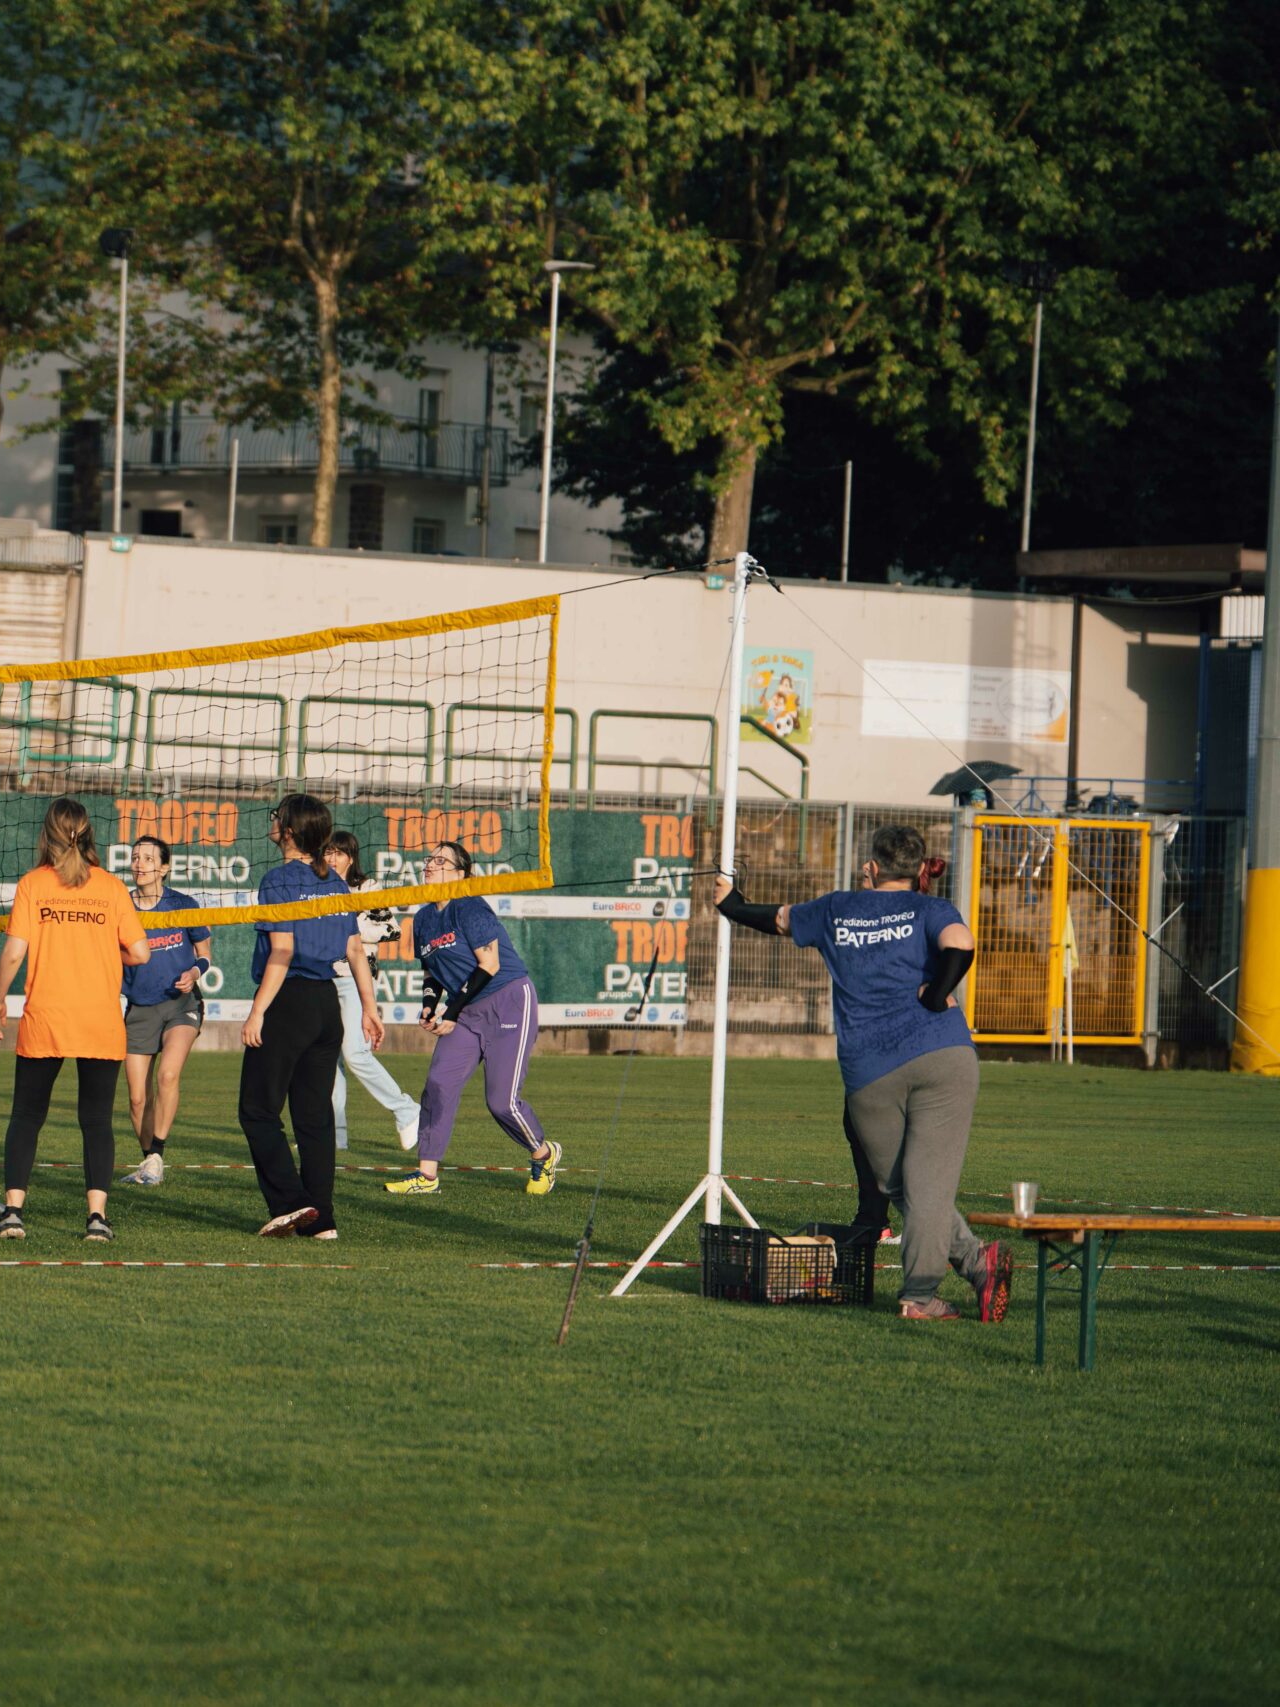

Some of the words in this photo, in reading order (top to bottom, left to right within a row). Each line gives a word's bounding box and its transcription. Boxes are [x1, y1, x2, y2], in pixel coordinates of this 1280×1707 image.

[114, 799, 239, 848] TROFEO
[384, 807, 502, 855] TROFEO
[108, 844, 250, 883] PERNO
[626, 885, 661, 893] gruppo
[78, 898, 109, 908] TROFEO
[40, 907, 106, 925] PATERNO
[843, 918, 879, 927] edizione
[880, 911, 915, 925] TROFEO
[835, 925, 913, 948] PATERNO
[597, 991, 633, 1000] gruppo
